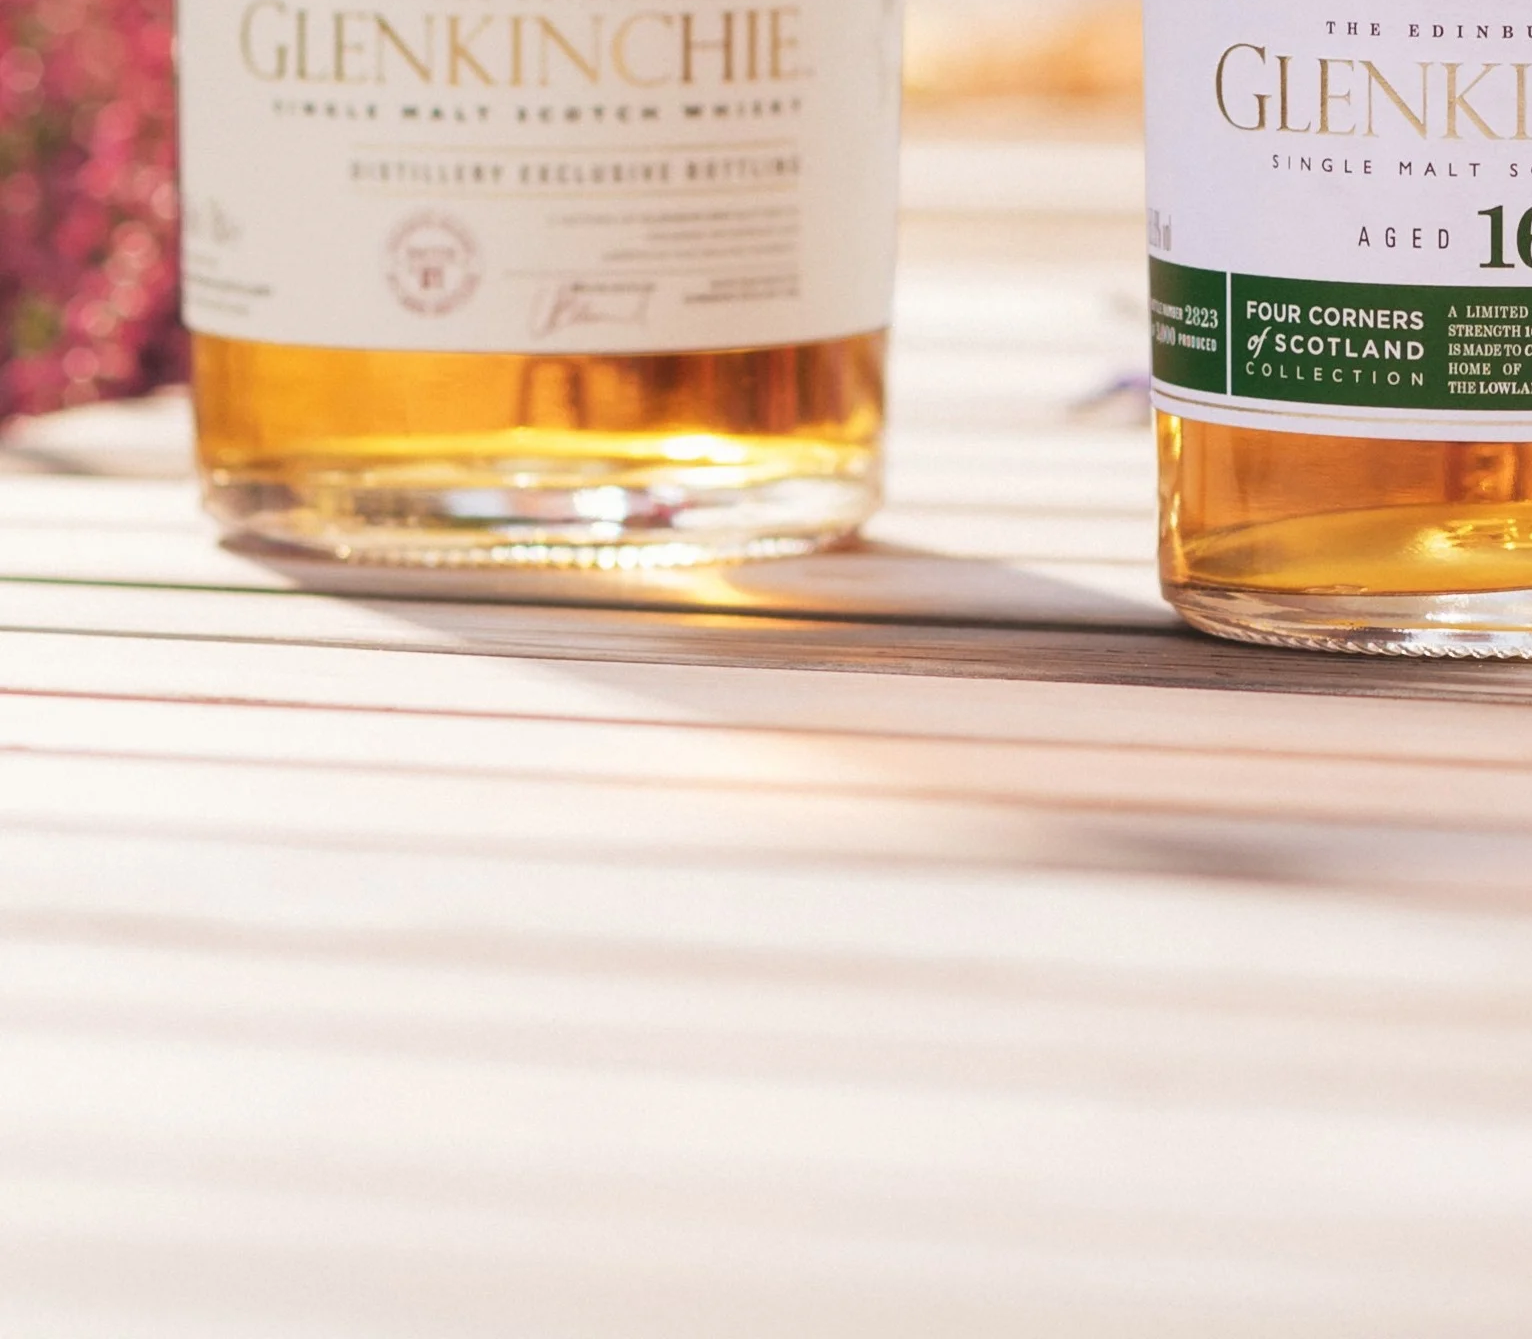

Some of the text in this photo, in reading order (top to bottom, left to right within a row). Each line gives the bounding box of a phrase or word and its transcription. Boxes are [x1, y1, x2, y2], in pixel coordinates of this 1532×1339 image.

[1326, 21, 1381, 36] THE
[1272, 154, 1372, 175] SINGLE
[1399, 161, 1481, 177] MALT
[1358, 226, 1449, 249] AGED
[1184, 305, 1219, 329] 2823
[1246, 300, 1424, 331] FOUR CORNERS
[1448, 306, 1457, 318] A
[1466, 306, 1529, 318] LIMITED
[1448, 324, 1521, 338] STRENGTH
[1178, 332, 1217, 353] PRODUCED
[1247, 326, 1424, 360] of SCOTLAND
[1448, 343, 1461, 356] IS
[1463, 343, 1501, 356] MADE
[1503, 344, 1522, 356] TO
[1246, 361, 1424, 386] COLLECTION
[1448, 362, 1491, 375] HOME
[1502, 363, 1522, 375] OF
[1447, 381, 1476, 394] THE
